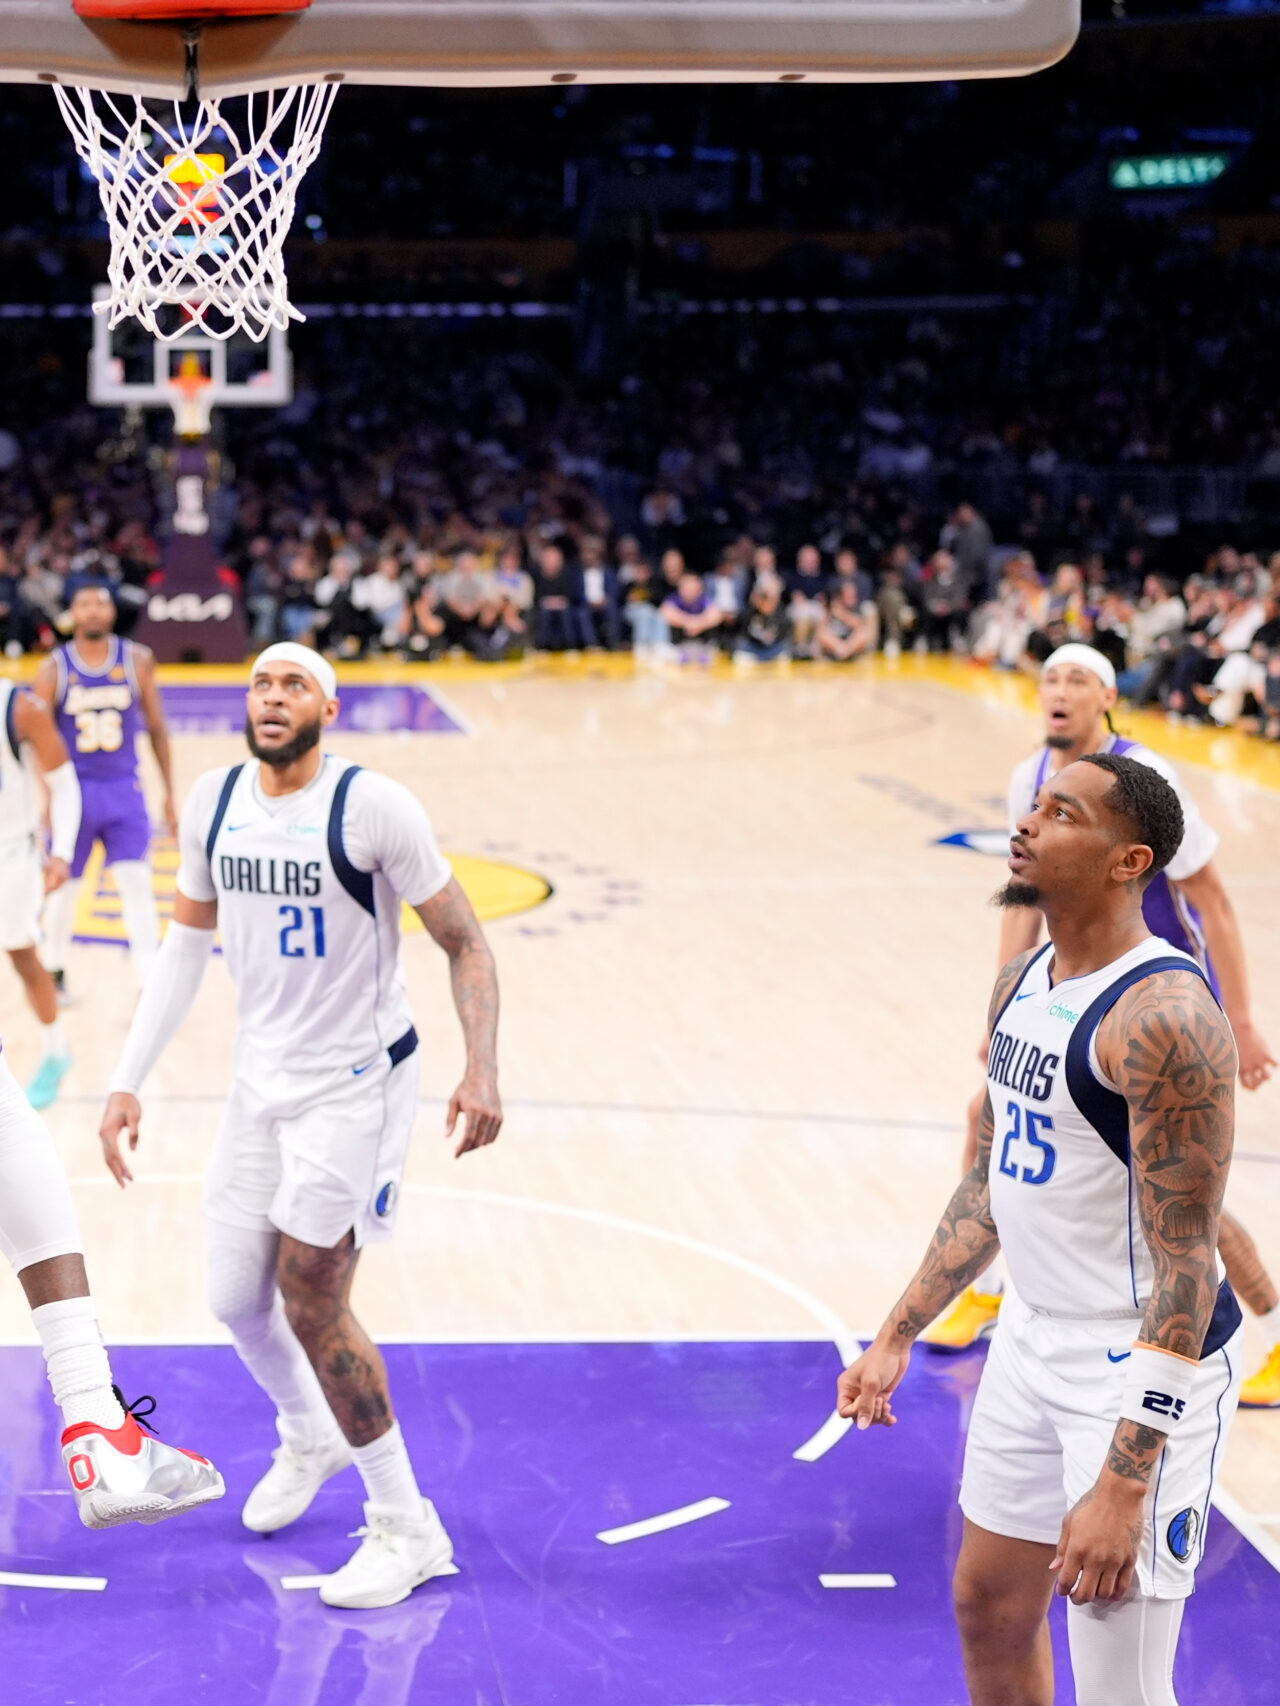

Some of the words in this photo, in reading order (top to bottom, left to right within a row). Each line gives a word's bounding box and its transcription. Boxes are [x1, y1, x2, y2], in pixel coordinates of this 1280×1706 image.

[220, 855, 322, 898] DALLAS
[278, 905, 326, 958] 21
[1048, 1001, 1080, 1026] chime
[987, 1029, 1061, 1103] DALLAS
[999, 1100, 1058, 1186] 25
